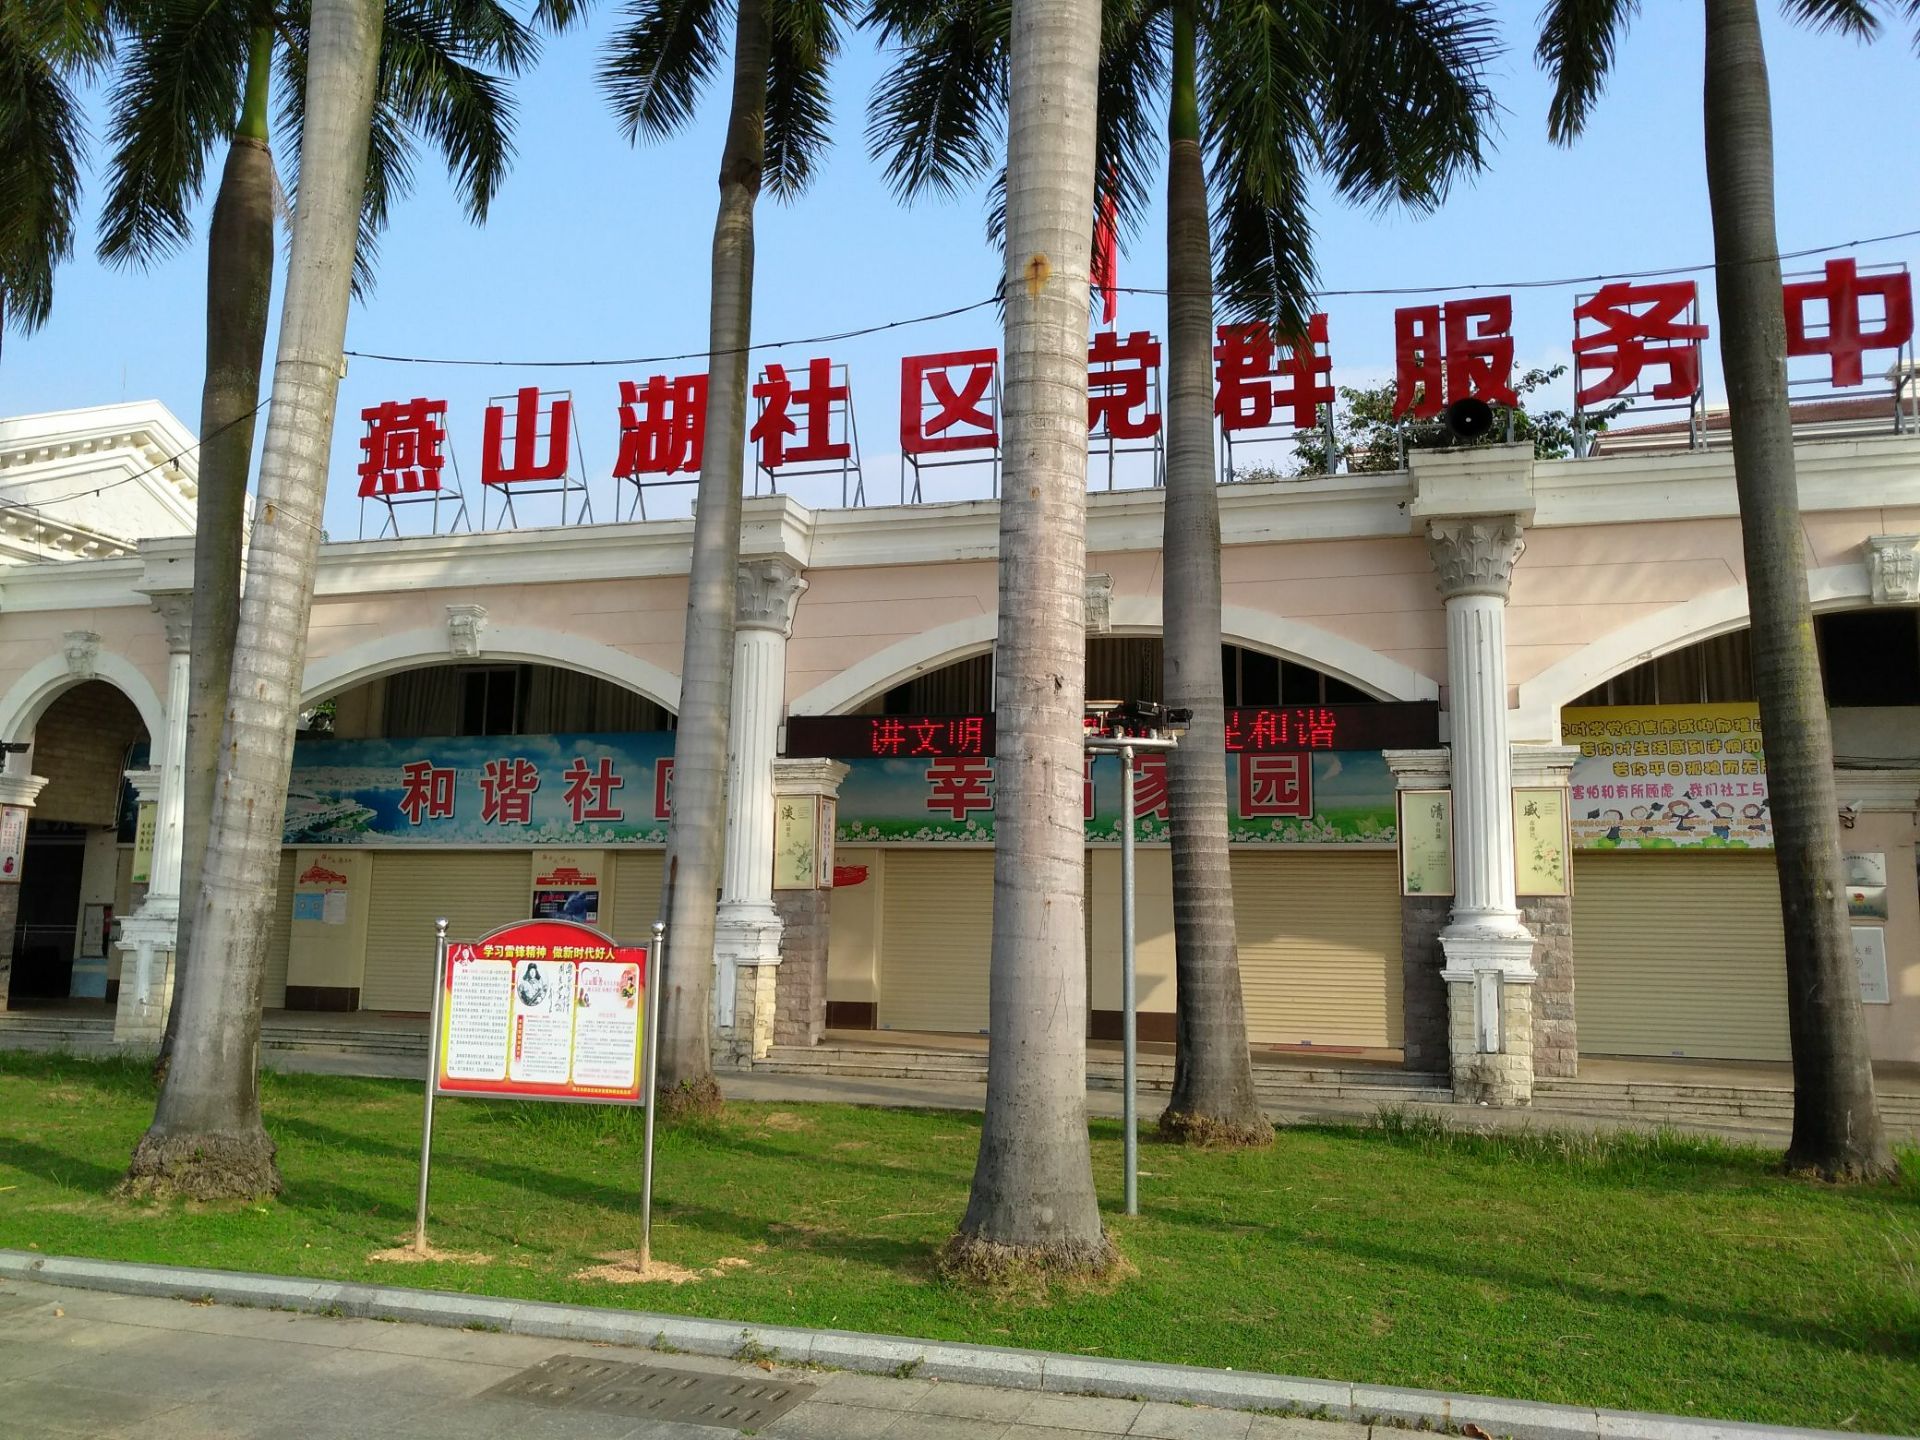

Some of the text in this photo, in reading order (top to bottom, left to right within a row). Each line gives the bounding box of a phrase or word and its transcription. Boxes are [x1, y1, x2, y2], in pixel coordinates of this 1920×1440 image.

[871, 718, 984, 755] 讲文明
[483, 944, 616, 960] 学习雷锋精神 做新时代好人
